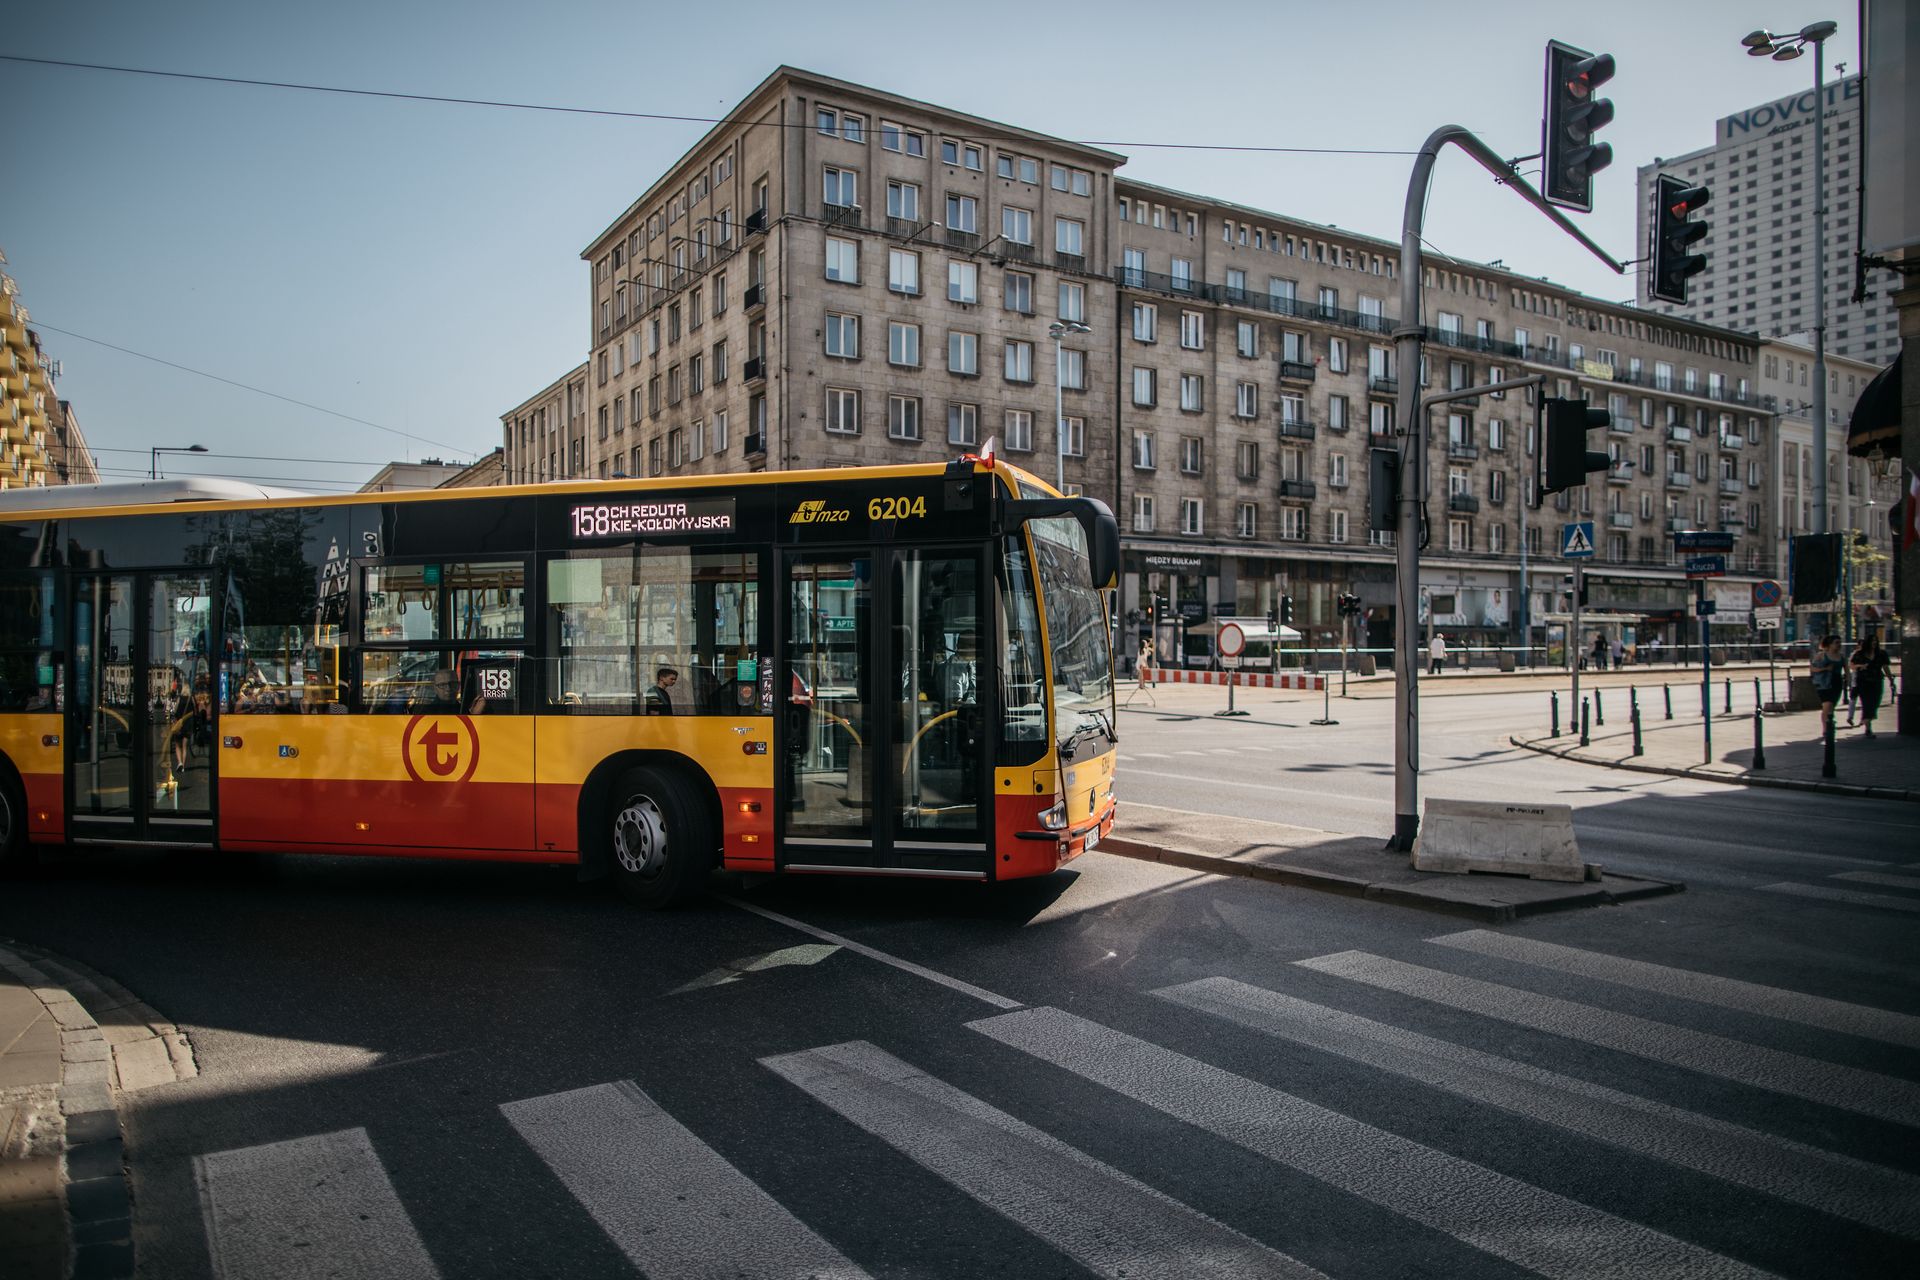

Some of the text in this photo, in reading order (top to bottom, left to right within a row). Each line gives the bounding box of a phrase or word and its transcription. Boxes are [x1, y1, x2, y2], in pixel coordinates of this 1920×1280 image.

[611, 504, 686, 518] CH REDUTA
[868, 496, 927, 521] 6204
[571, 506, 610, 536] 158
[611, 515, 731, 532] KIE-KOŁOMYJSKA
[479, 669, 511, 689] 158
[483, 689, 507, 698] TRASA
